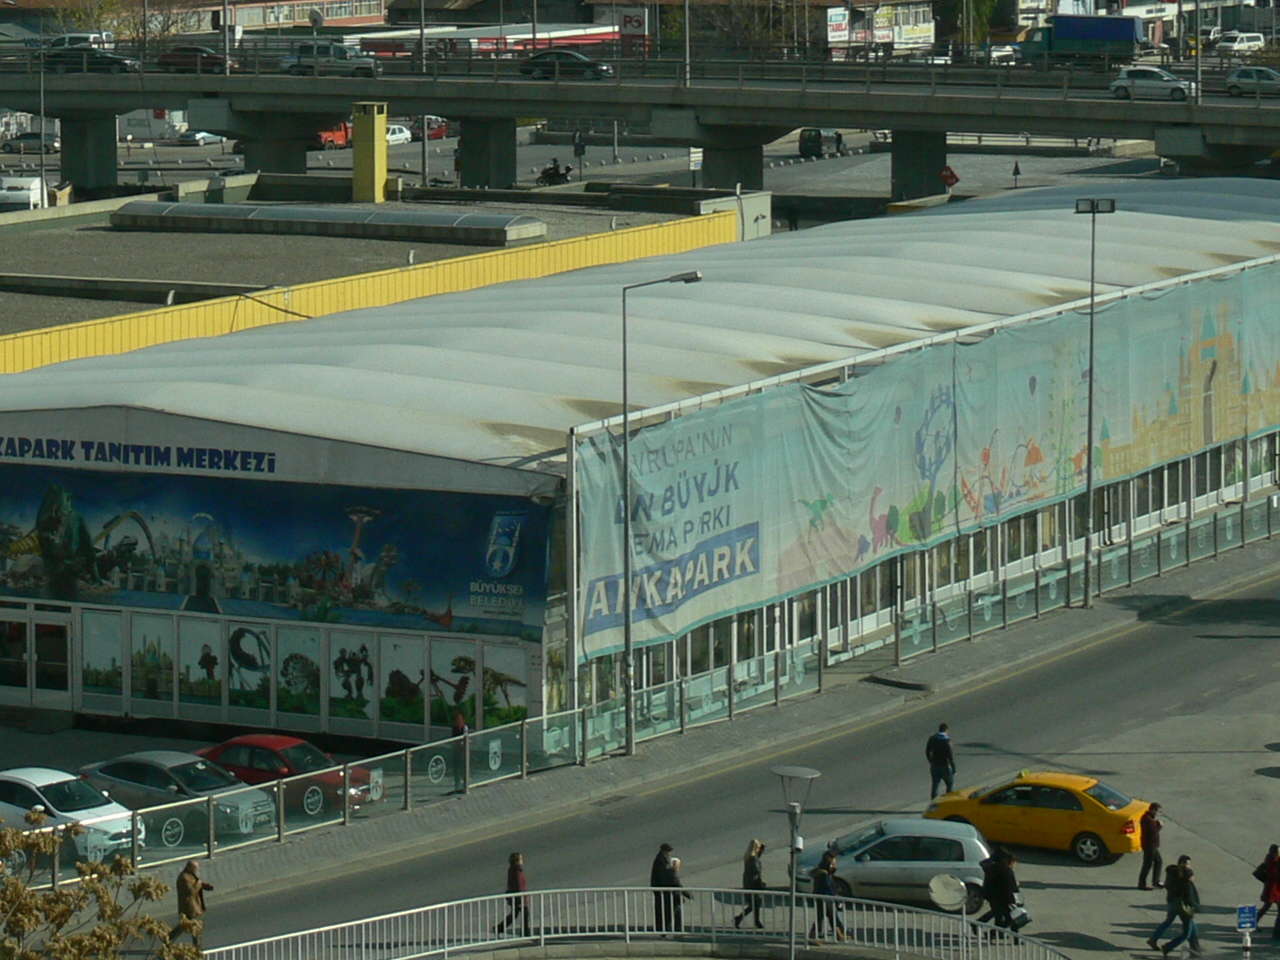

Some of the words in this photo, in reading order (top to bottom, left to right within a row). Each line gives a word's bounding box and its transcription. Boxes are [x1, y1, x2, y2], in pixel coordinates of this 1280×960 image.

[81, 441, 171, 467] TANITIM
[176, 447, 276, 474] MERKEZİ
[631, 528, 678, 558] EMA
[683, 505, 731, 545] PRKI
[588, 537, 756, 620] ANKAPARK
